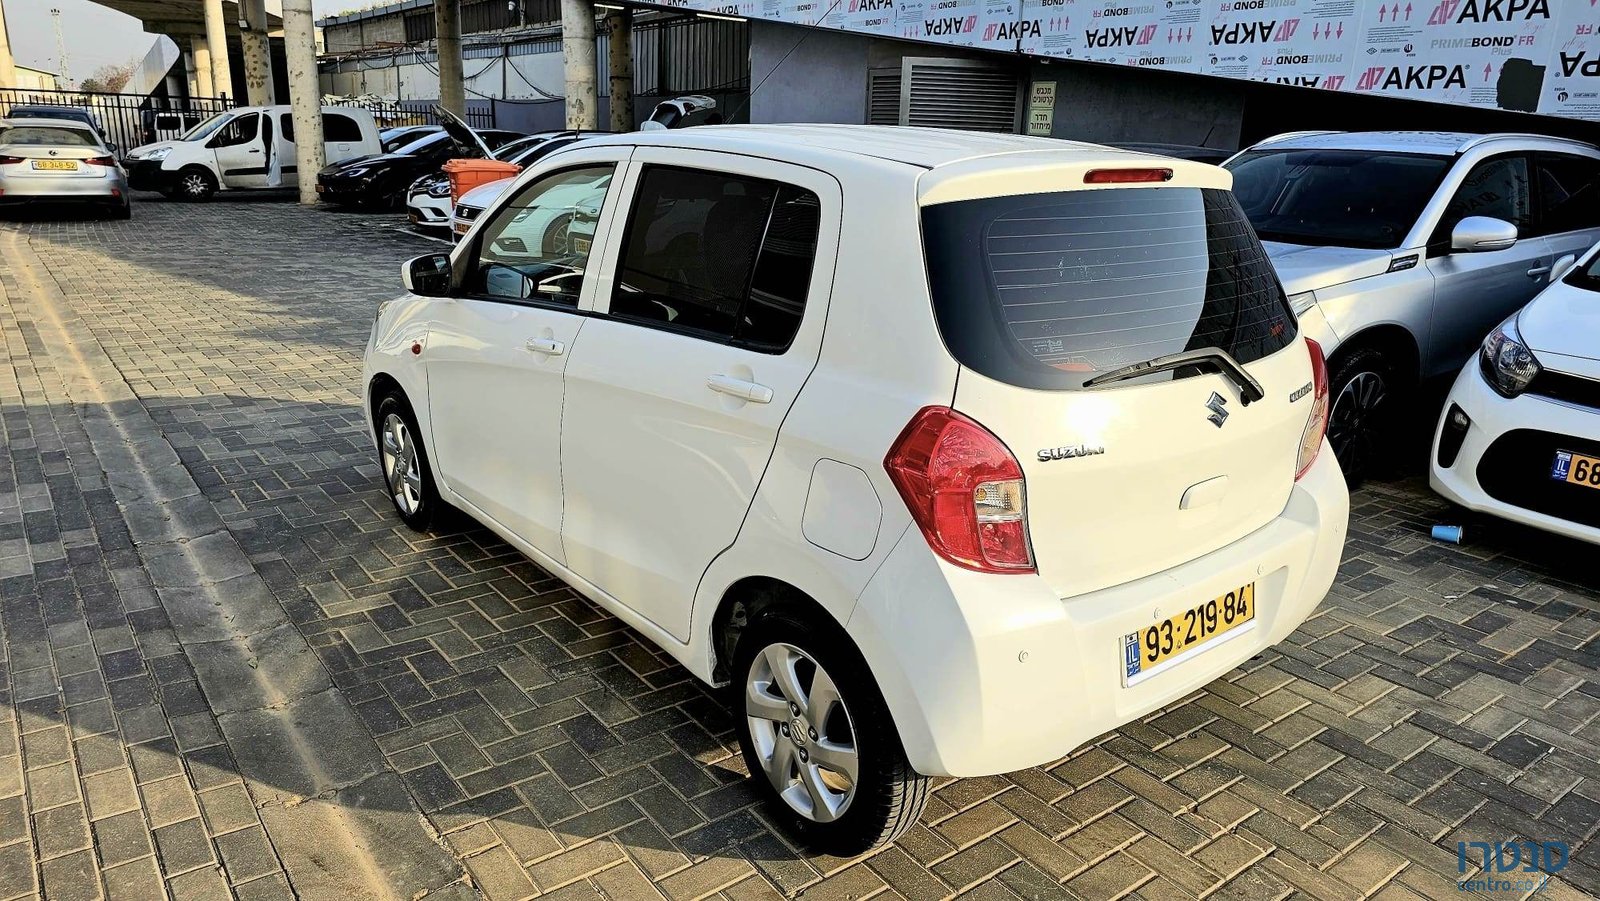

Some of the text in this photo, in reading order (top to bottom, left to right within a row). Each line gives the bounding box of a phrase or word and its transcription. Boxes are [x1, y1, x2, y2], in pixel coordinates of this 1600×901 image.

[1456, 0, 1551, 25] AKPA
[924, 17, 964, 36] AKPA
[996, 19, 1042, 40] AKPA
[1085, 26, 1138, 48] AKPA
[1211, 20, 1276, 46] AKPA
[1431, 35, 1535, 49] PRIMEBOND FR
[1491, 47, 1512, 56] Plus
[1381, 65, 1467, 90] AKPA
[1035, 113, 1048, 121] חדר
